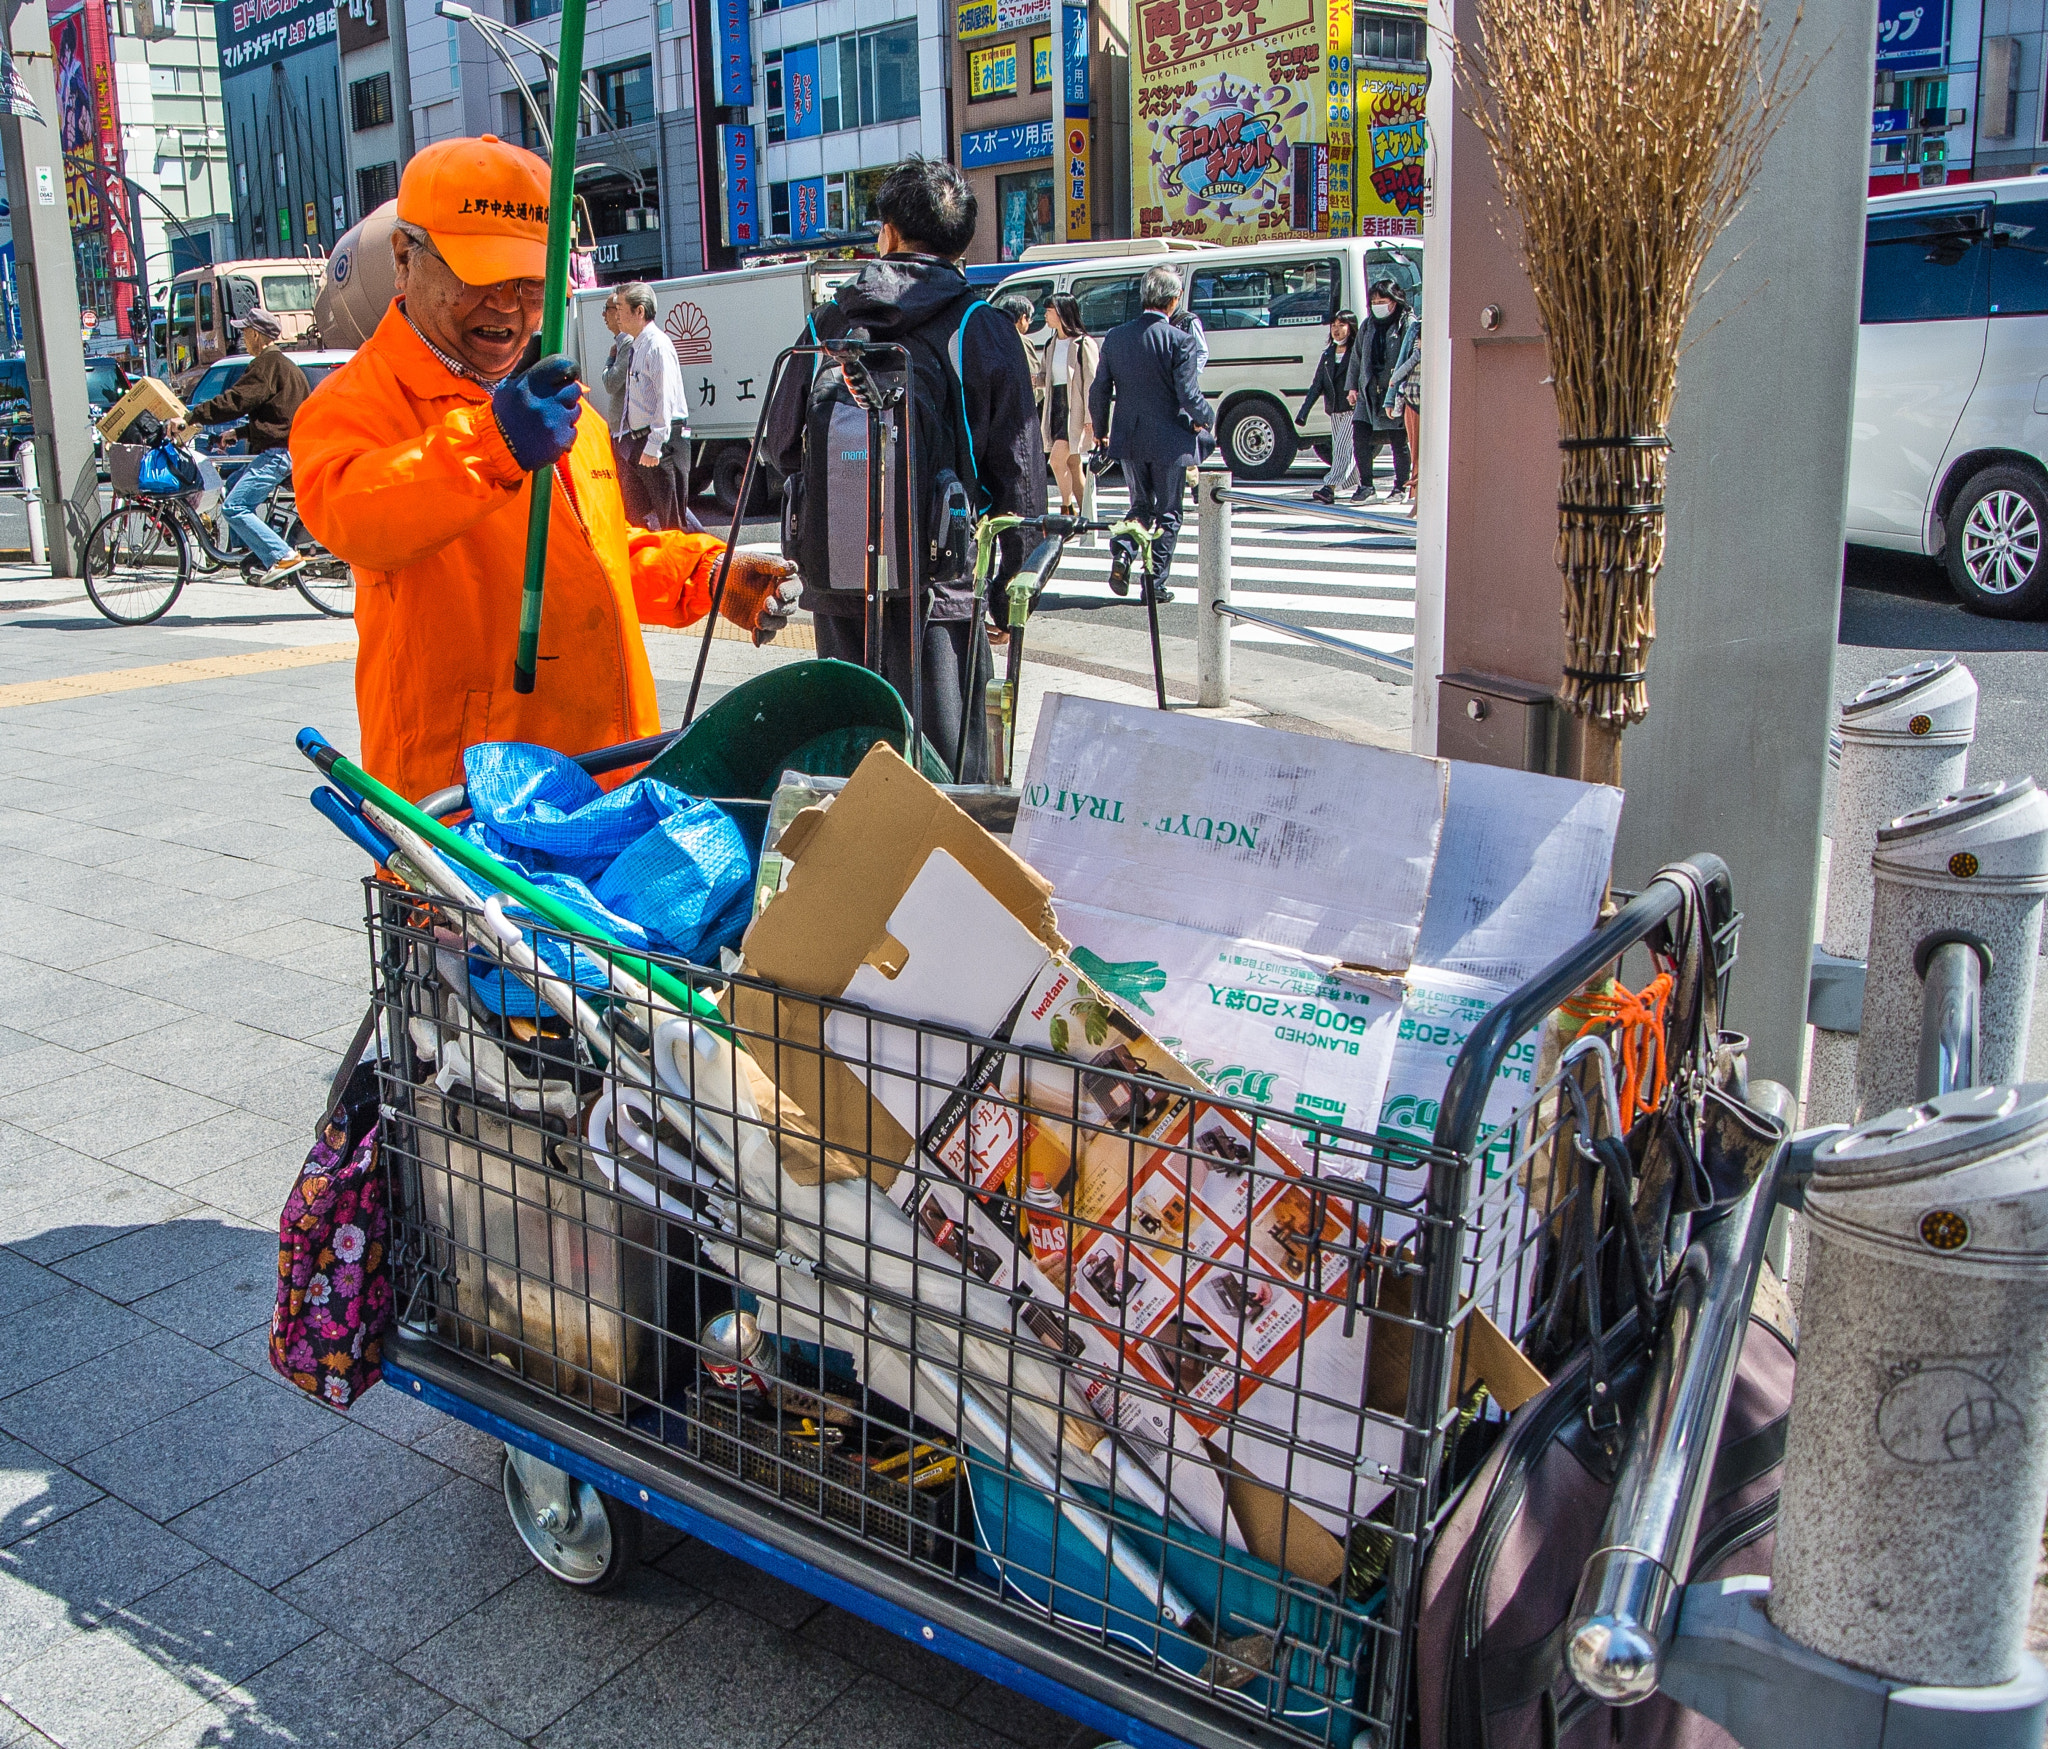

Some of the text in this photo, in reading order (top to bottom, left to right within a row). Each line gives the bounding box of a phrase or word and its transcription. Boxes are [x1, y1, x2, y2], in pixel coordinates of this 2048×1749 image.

[959, 4, 997, 33] お部屋探し
[1072, 9, 1084, 100] スポーツ用品
[1142, 25, 1317, 83] Yokohama Ticket Service
[1266, 43, 1320, 69] プロ野球
[982, 56, 1016, 91] お部屋
[1269, 64, 1320, 85] サッカー
[1370, 81, 1407, 95] コンサート
[793, 72, 803, 126] カラオケ
[803, 74, 812, 113] ひとり
[1138, 80, 1198, 104] スペシャル
[1138, 98, 1182, 119] イベント
[969, 124, 1054, 155] スポーツ用品
[1178, 112, 1246, 163] ヨコハマ
[1375, 125, 1422, 163] チケット
[1205, 133, 1274, 183] チケット
[734, 131, 751, 240] カラオケ館
[1071, 157, 1086, 200] 松屋
[1201, 184, 1245, 198] SERVICE
[1317, 146, 1329, 212] 外貨両替
[798, 184, 808, 236] カラオケ
[807, 186, 817, 225] ひとり
[1139, 218, 1208, 238] ミュージカル
[1363, 217, 1417, 236] 委託販売
[1031, 973, 1069, 1021] Iwatani
[1274, 1025, 1360, 1056] BLANCHED
[1029, 1223, 1067, 1252] GAS
